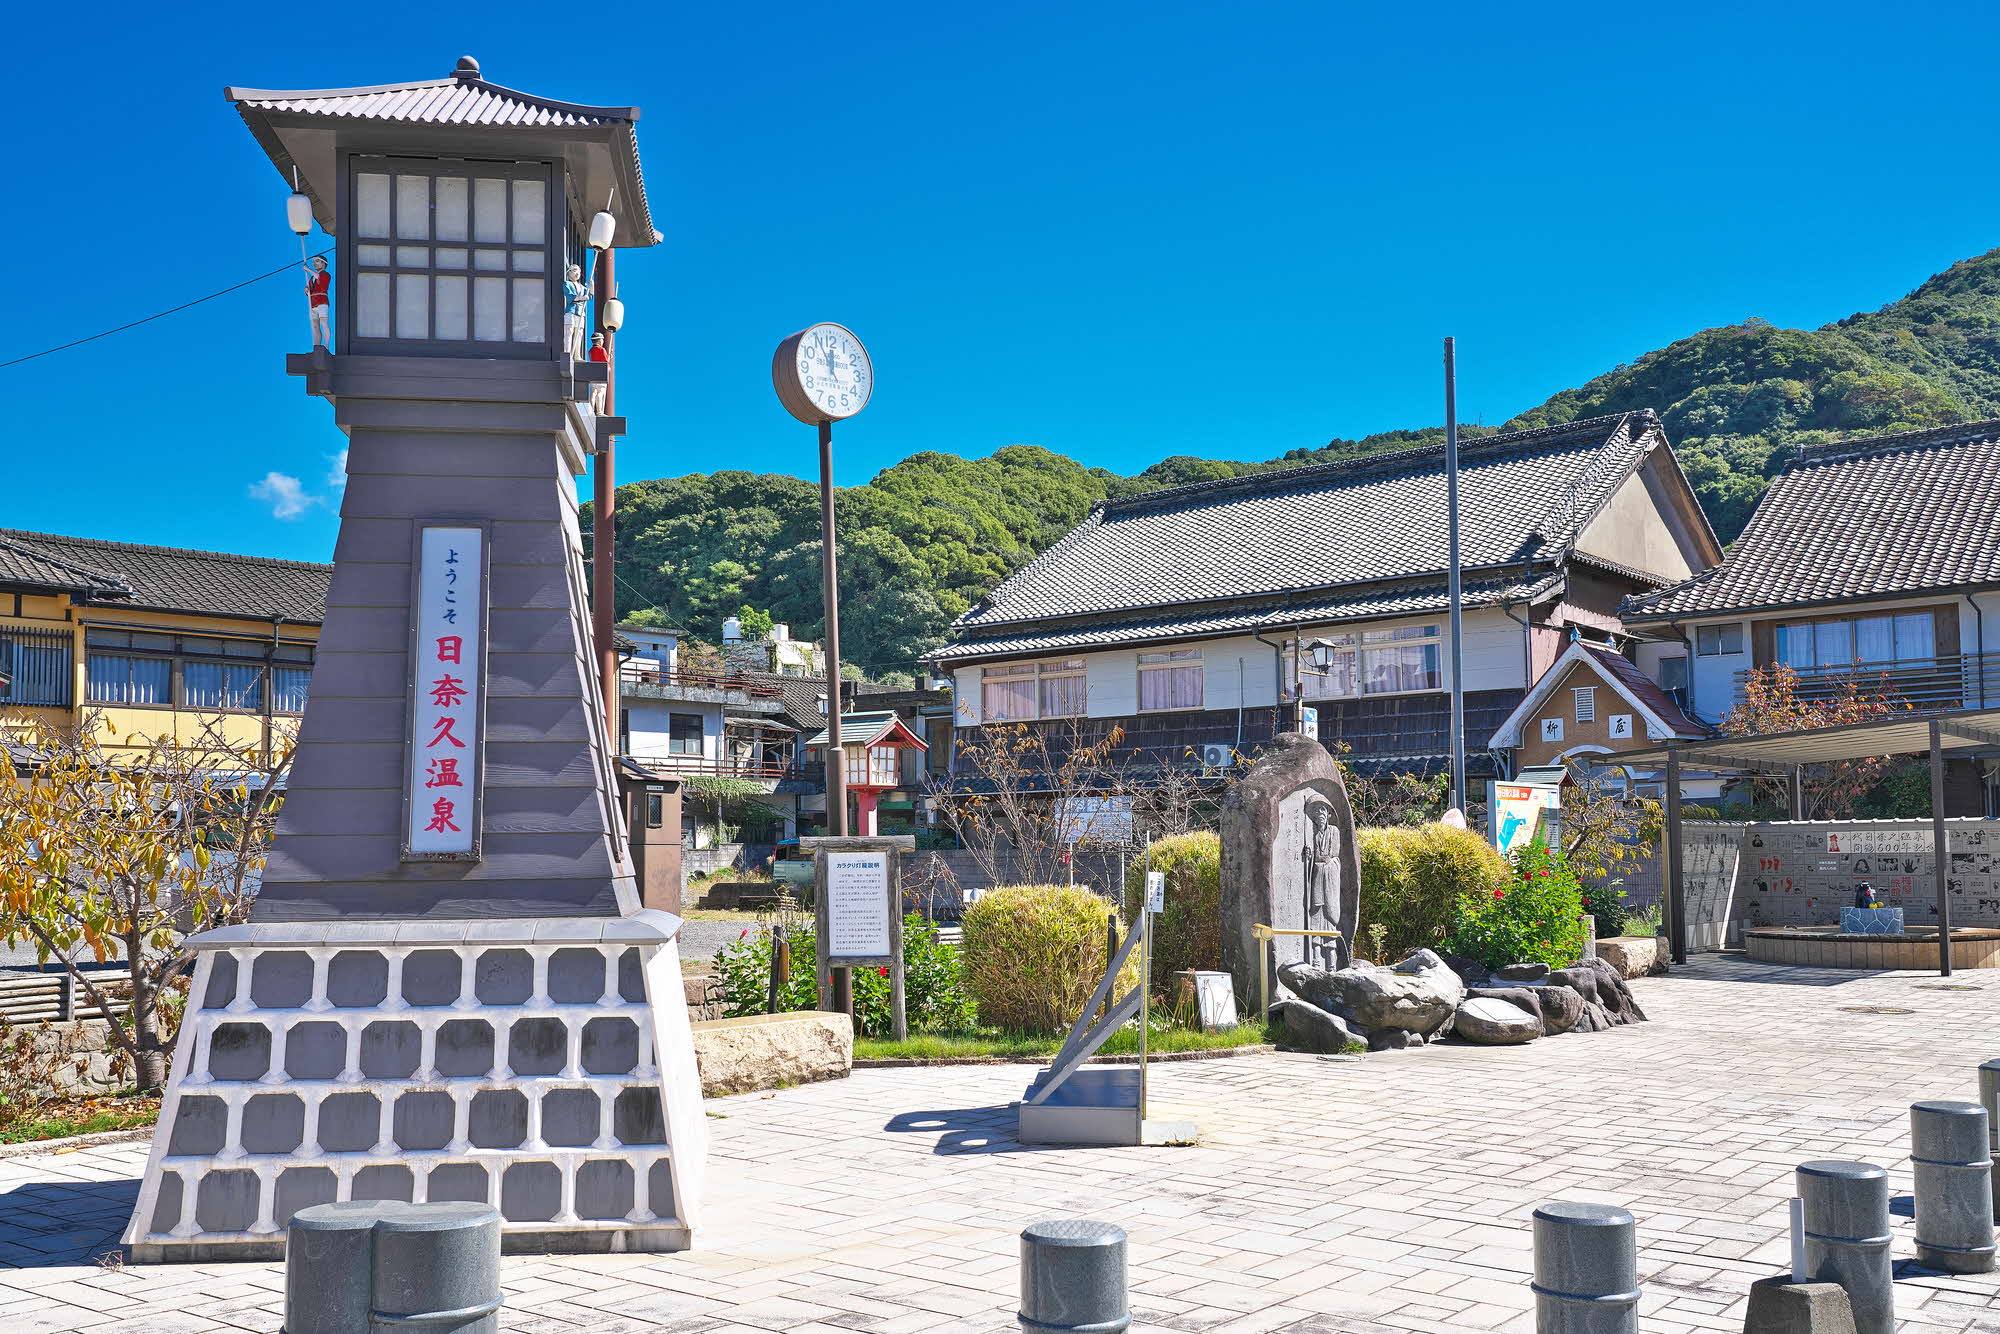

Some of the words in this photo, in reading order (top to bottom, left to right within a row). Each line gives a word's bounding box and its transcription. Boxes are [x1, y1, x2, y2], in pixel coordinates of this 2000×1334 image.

[826, 335, 837, 349] 12
[803, 346, 815, 359] 10
[800, 360, 809, 374] 9
[849, 354, 857, 367] 2
[805, 376, 814, 389] 8
[852, 370, 861, 383] 3
[816, 389, 824, 402] 7
[849, 385, 858, 397] 4
[827, 395, 836, 409] 6
[840, 394, 849, 407] 5
[443, 549, 459, 625] ようこそ
[1614, 717, 1626, 735] 屋
[424, 635, 470, 834] 日奈久温泉
